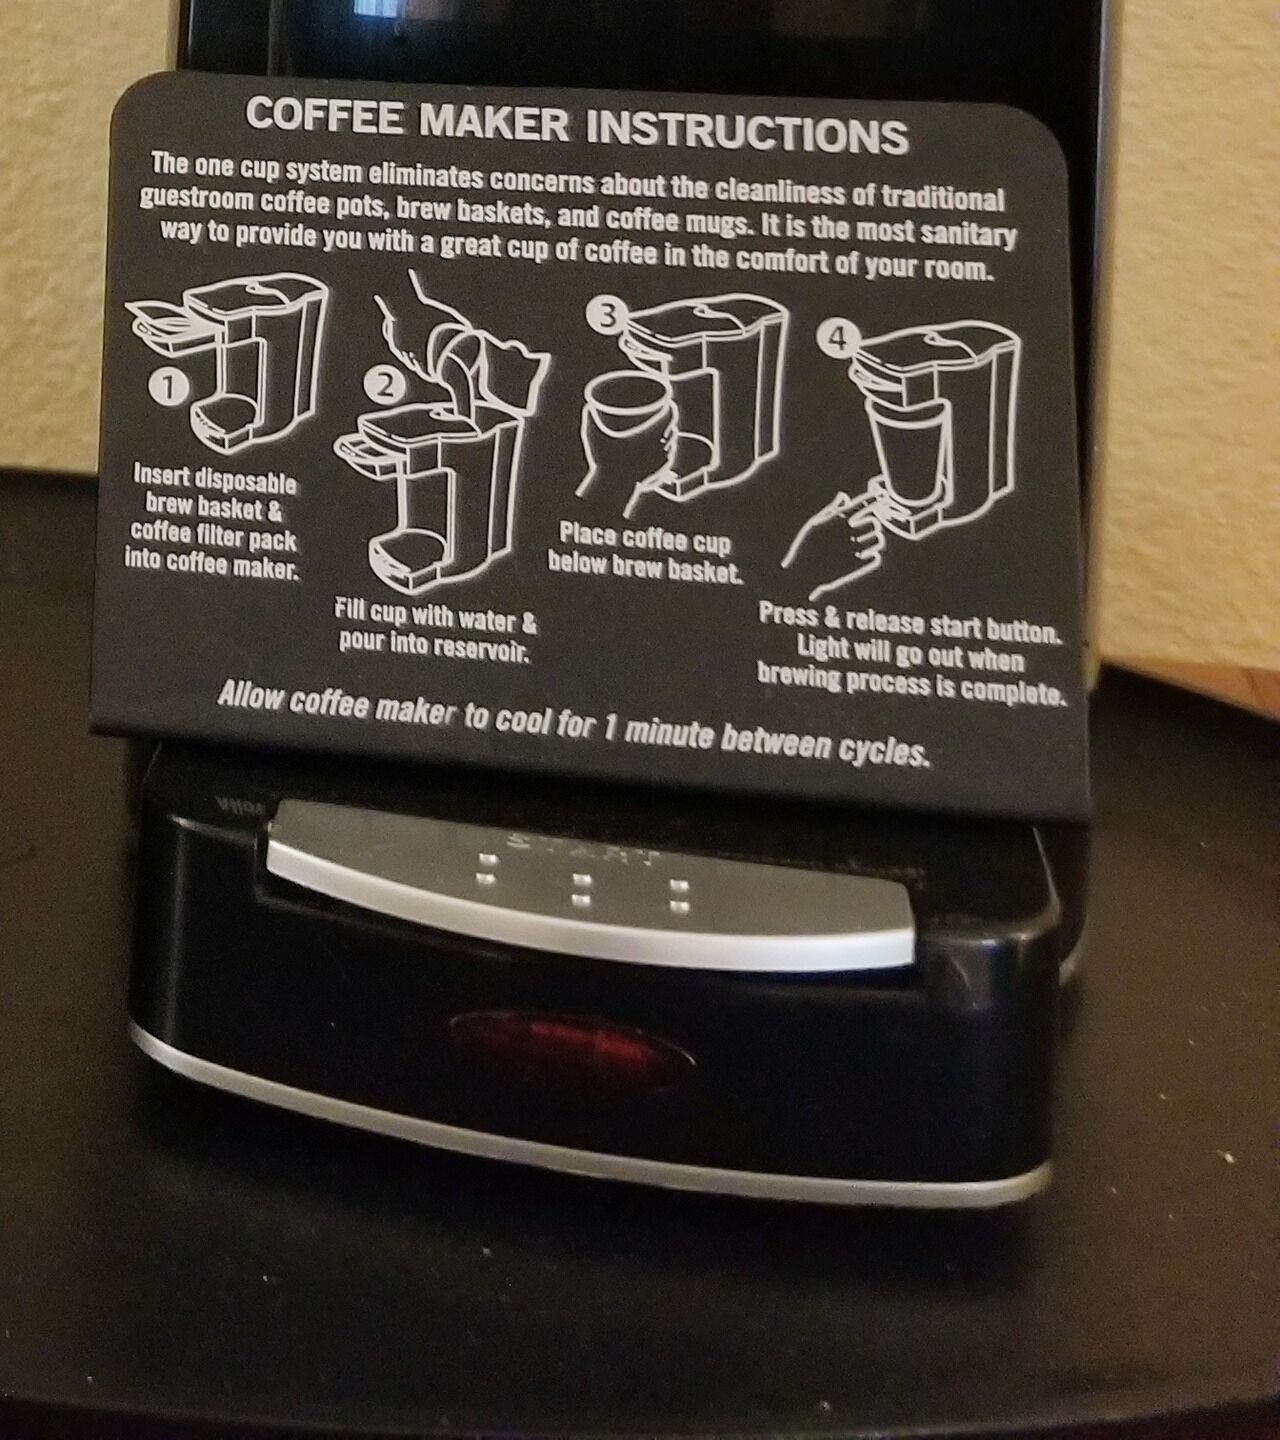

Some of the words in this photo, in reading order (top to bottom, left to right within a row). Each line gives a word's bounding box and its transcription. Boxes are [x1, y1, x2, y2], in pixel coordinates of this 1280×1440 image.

[246, 95, 408, 135] COFFEE
[419, 102, 571, 143] MAKER
[587, 108, 910, 156] INSTRUCTIONS
[150, 149, 192, 175] The
[194, 156, 236, 177] one
[240, 159, 281, 184] cup
[285, 159, 364, 186] system
[368, 160, 485, 190] eliminates
[489, 171, 597, 195] concerns
[599, 171, 668, 198] about
[669, 174, 711, 200] the
[714, 176, 848, 206] cleanliness
[851, 181, 878, 208] of
[880, 183, 1006, 213] traditional
[139, 185, 255, 212] guestroom
[260, 188, 332, 215] coffee
[336, 193, 391, 221] pots,
[396, 194, 454, 222] brew
[456, 197, 553, 230] baskets,
[557, 204, 601, 229] and
[605, 205, 681, 233] coffee
[685, 213, 756, 240] mugs.
[761, 211, 782, 238] It
[785, 212, 808, 239] is
[809, 214, 851, 241] the
[855, 218, 917, 244] most
[919, 220, 1019, 253] sanitary
[159, 220, 205, 245] way
[206, 218, 231, 243] to
[235, 221, 319, 248] provide
[322, 228, 363, 253] you
[367, 227, 416, 253] with
[419, 234, 436, 254] a
[439, 233, 503, 260] great
[506, 238, 550, 265] cup
[554, 236, 581, 262] of
[584, 238, 659, 266] coffee
[663, 241, 688, 268] in
[690, 242, 731, 270] the
[735, 247, 831, 274] comfort
[834, 250, 861, 276] of
[864, 255, 920, 281] your
[924, 259, 996, 282] room.
[133, 461, 192, 488] Insert
[194, 466, 298, 496] disposable
[145, 489, 194, 516] brew
[197, 493, 264, 522] basket
[267, 499, 284, 524] &
[130, 518, 193, 544] coffee
[196, 522, 246, 549] filter
[248, 529, 298, 554] pack
[559, 519, 619, 547] Place
[622, 525, 690, 552] coffee
[692, 534, 733, 559] cup
[124, 543, 162, 570] into
[166, 549, 229, 577] coffee
[232, 555, 301, 582] maker.
[547, 548, 609, 576] below
[611, 552, 664, 580] brew
[667, 556, 745, 586] basket.
[334, 595, 367, 622] Fill
[369, 603, 409, 629] cup
[411, 603, 455, 629] with
[457, 609, 518, 634] water
[521, 610, 539, 636] &
[758, 599, 820, 628] Press
[823, 604, 842, 630] &
[845, 607, 926, 636] release
[929, 614, 983, 641] start
[986, 616, 1064, 646] button.
[339, 630, 387, 653] pour
[389, 629, 431, 657] into
[433, 637, 531, 665] reservoir.
[797, 632, 852, 663] Light
[853, 637, 892, 664] will
[895, 644, 924, 669] go
[927, 645, 965, 670] out
[966, 646, 1026, 673] when
[756, 659, 843, 694] brewing
[845, 670, 933, 697] process
[935, 673, 957, 699] is
[960, 679, 1069, 708] complete.
[216, 678, 287, 711] Allow
[289, 687, 371, 720] coffee
[374, 695, 459, 726] maker
[464, 701, 491, 730] to
[495, 706, 554, 736] cool
[556, 708, 598, 739] for
[604, 712, 618, 742] 1
[624, 716, 716, 750] minute
[720, 721, 833, 760] between
[838, 735, 932, 769] cycles.
